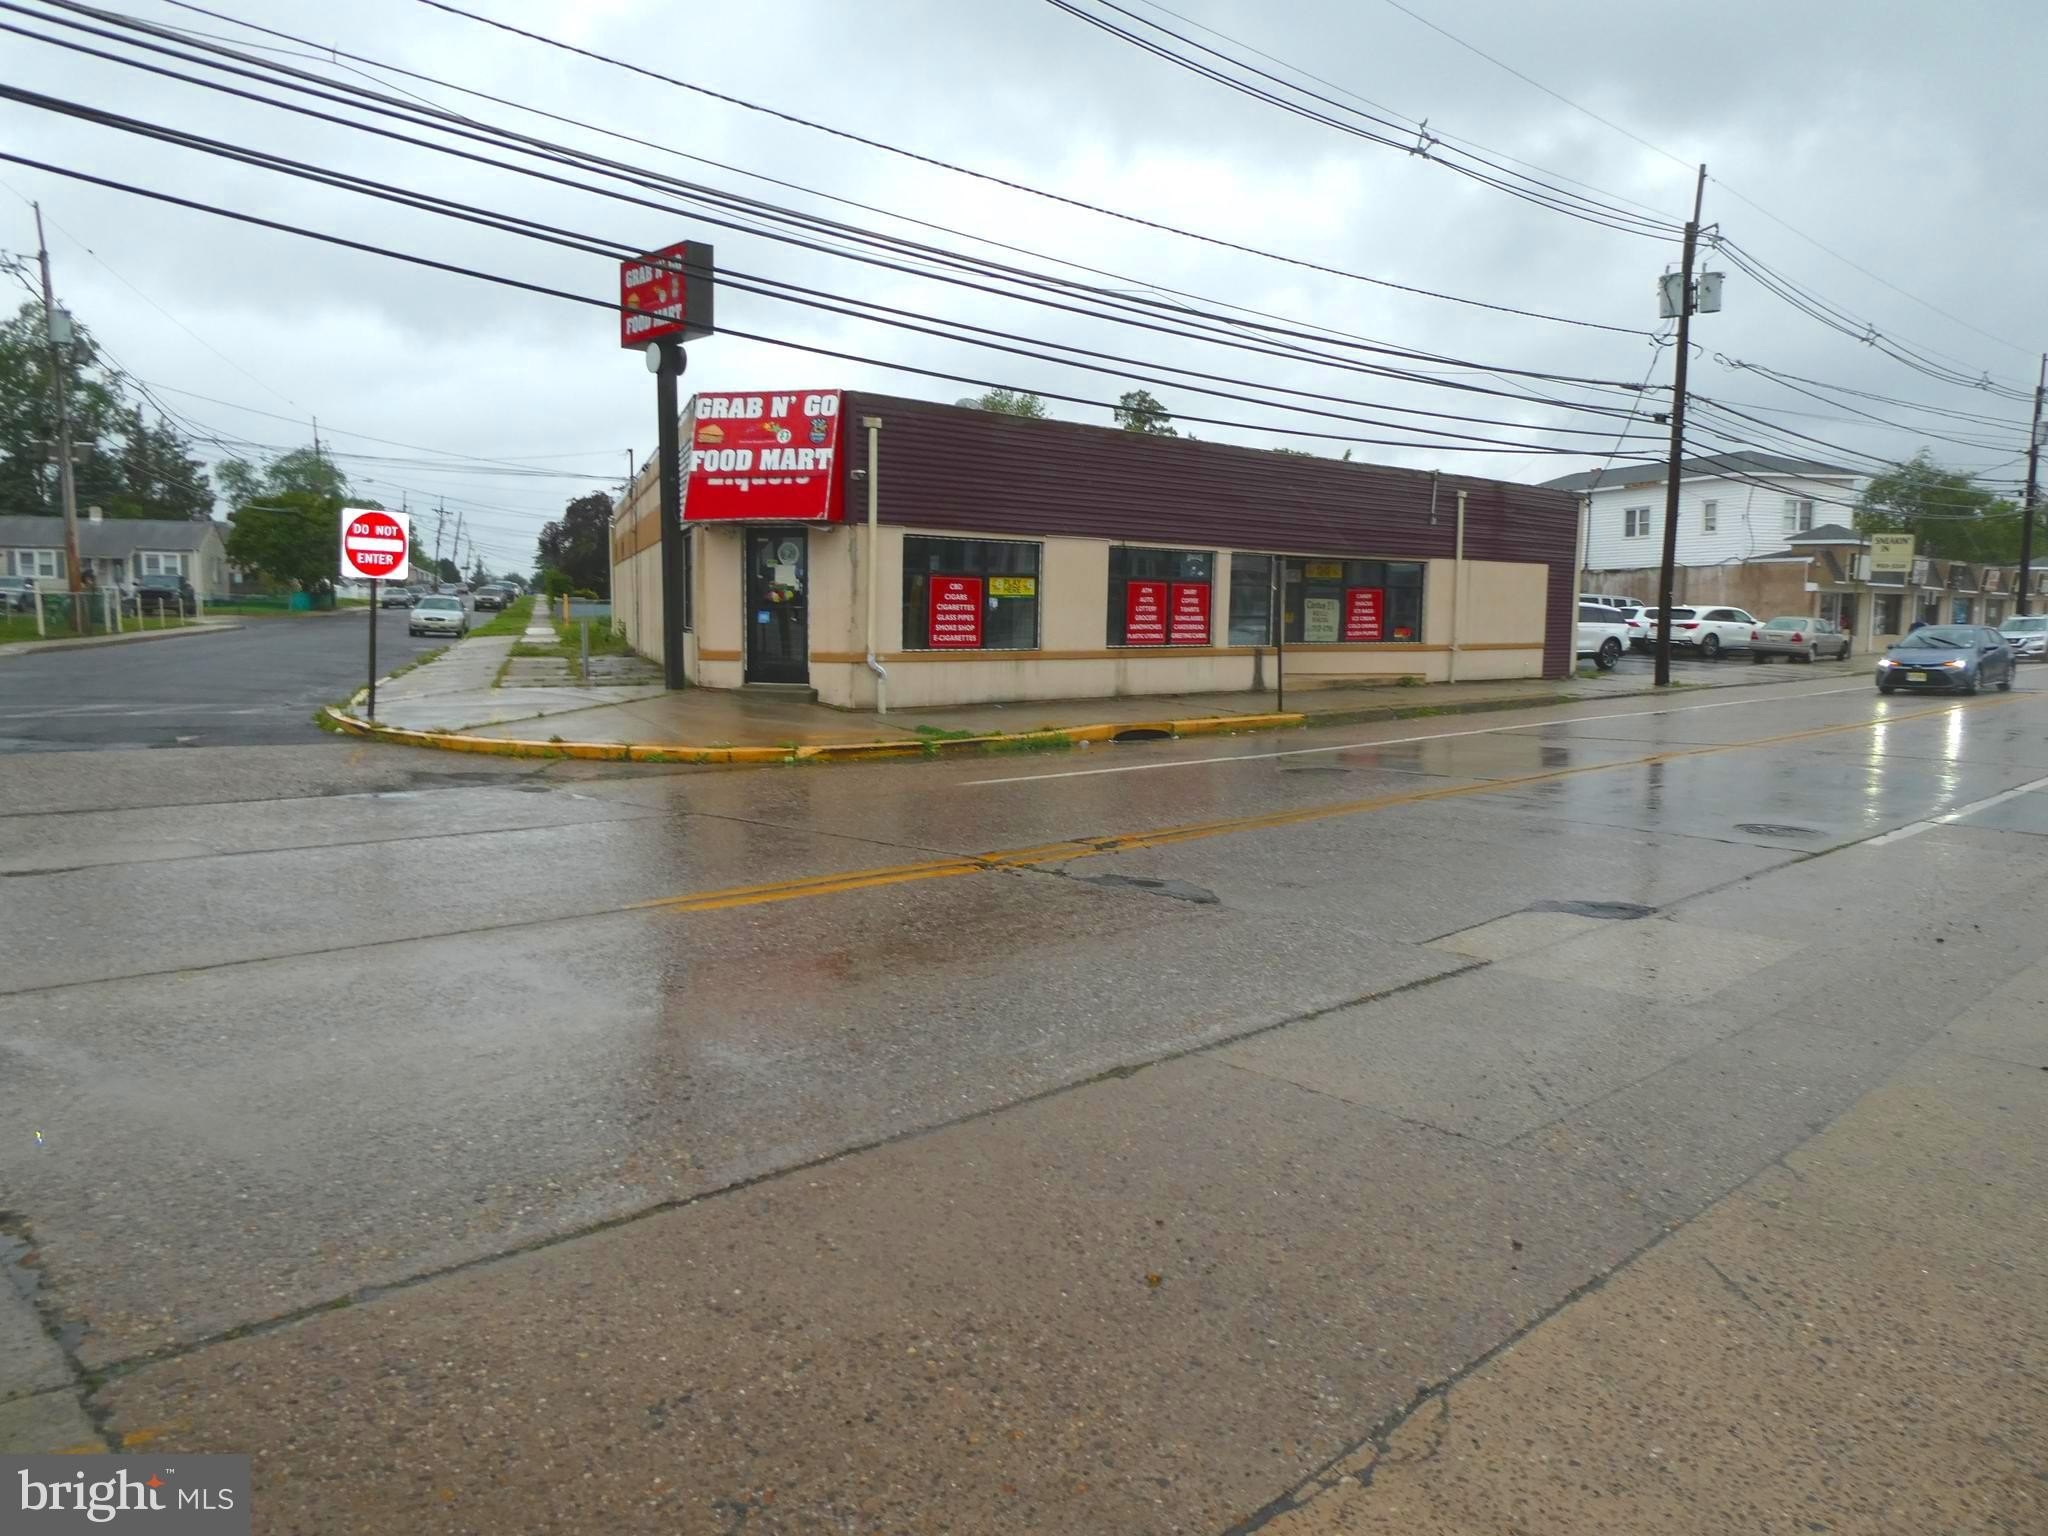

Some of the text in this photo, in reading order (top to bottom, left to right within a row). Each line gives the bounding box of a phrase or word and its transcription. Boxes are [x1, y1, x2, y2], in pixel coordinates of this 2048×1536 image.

[626, 265, 653, 288] GRAB
[626, 303, 683, 335] FOOD MART
[694, 394, 839, 419] GRAB N' GO
[688, 447, 833, 472] FOOD MART
[353, 523, 399, 537] DO NOT
[357, 553, 394, 565] ENTER
[949, 583, 964, 591] CBD
[944, 593, 968, 601] CIGARS
[936, 603, 976, 612] CIGARETTES
[936, 613, 975, 622] GLASS PIPES
[935, 624, 976, 632] SMOKE SHOP
[933, 634, 977, 643] E-CIGARETTES
